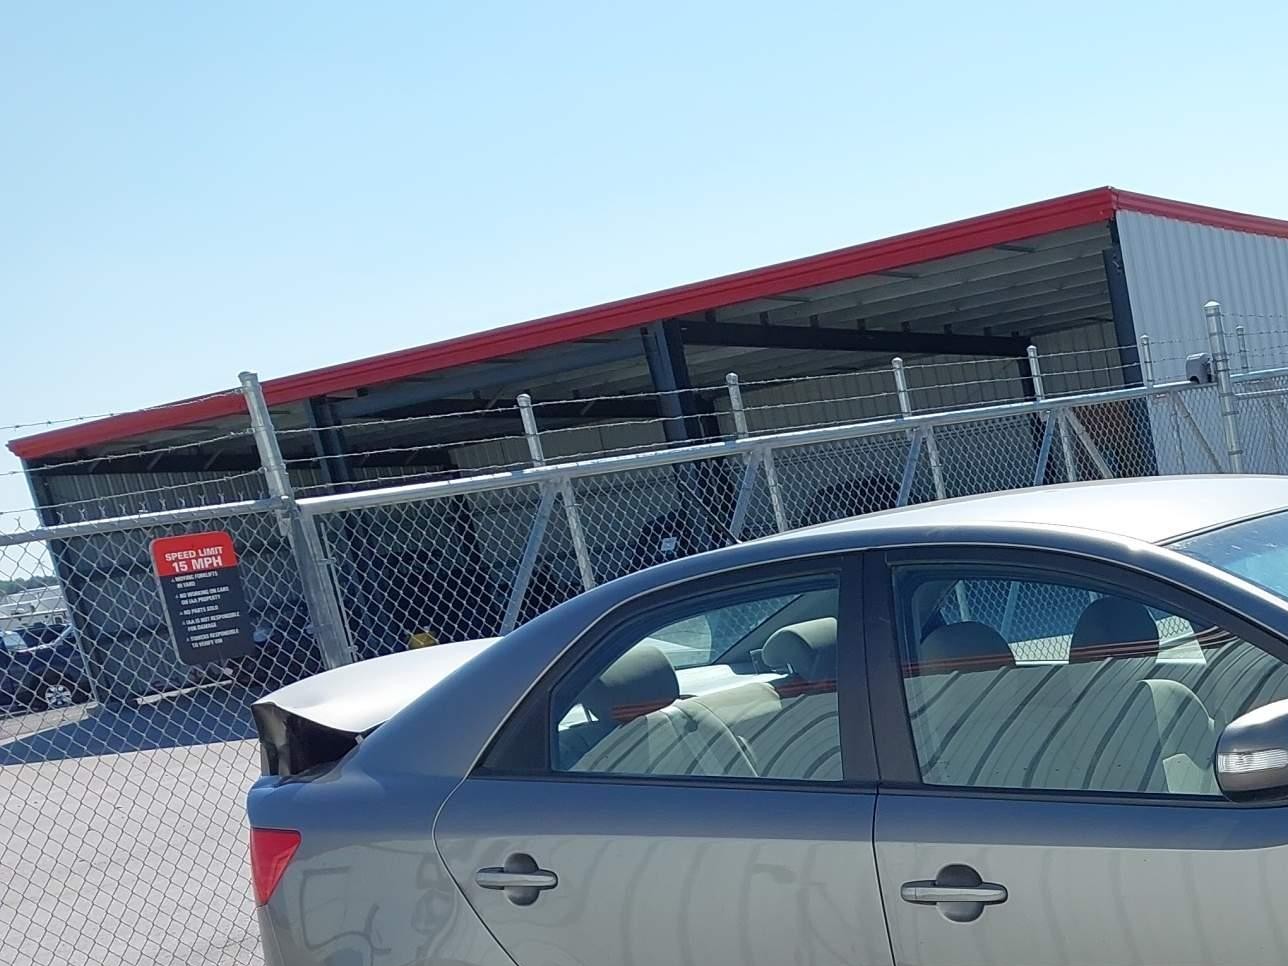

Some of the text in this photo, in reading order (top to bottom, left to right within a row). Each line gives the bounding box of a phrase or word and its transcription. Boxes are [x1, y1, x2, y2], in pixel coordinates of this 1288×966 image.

[165, 546, 224, 561] SPEED LIMIT
[172, 555, 223, 573] 15 MPH
